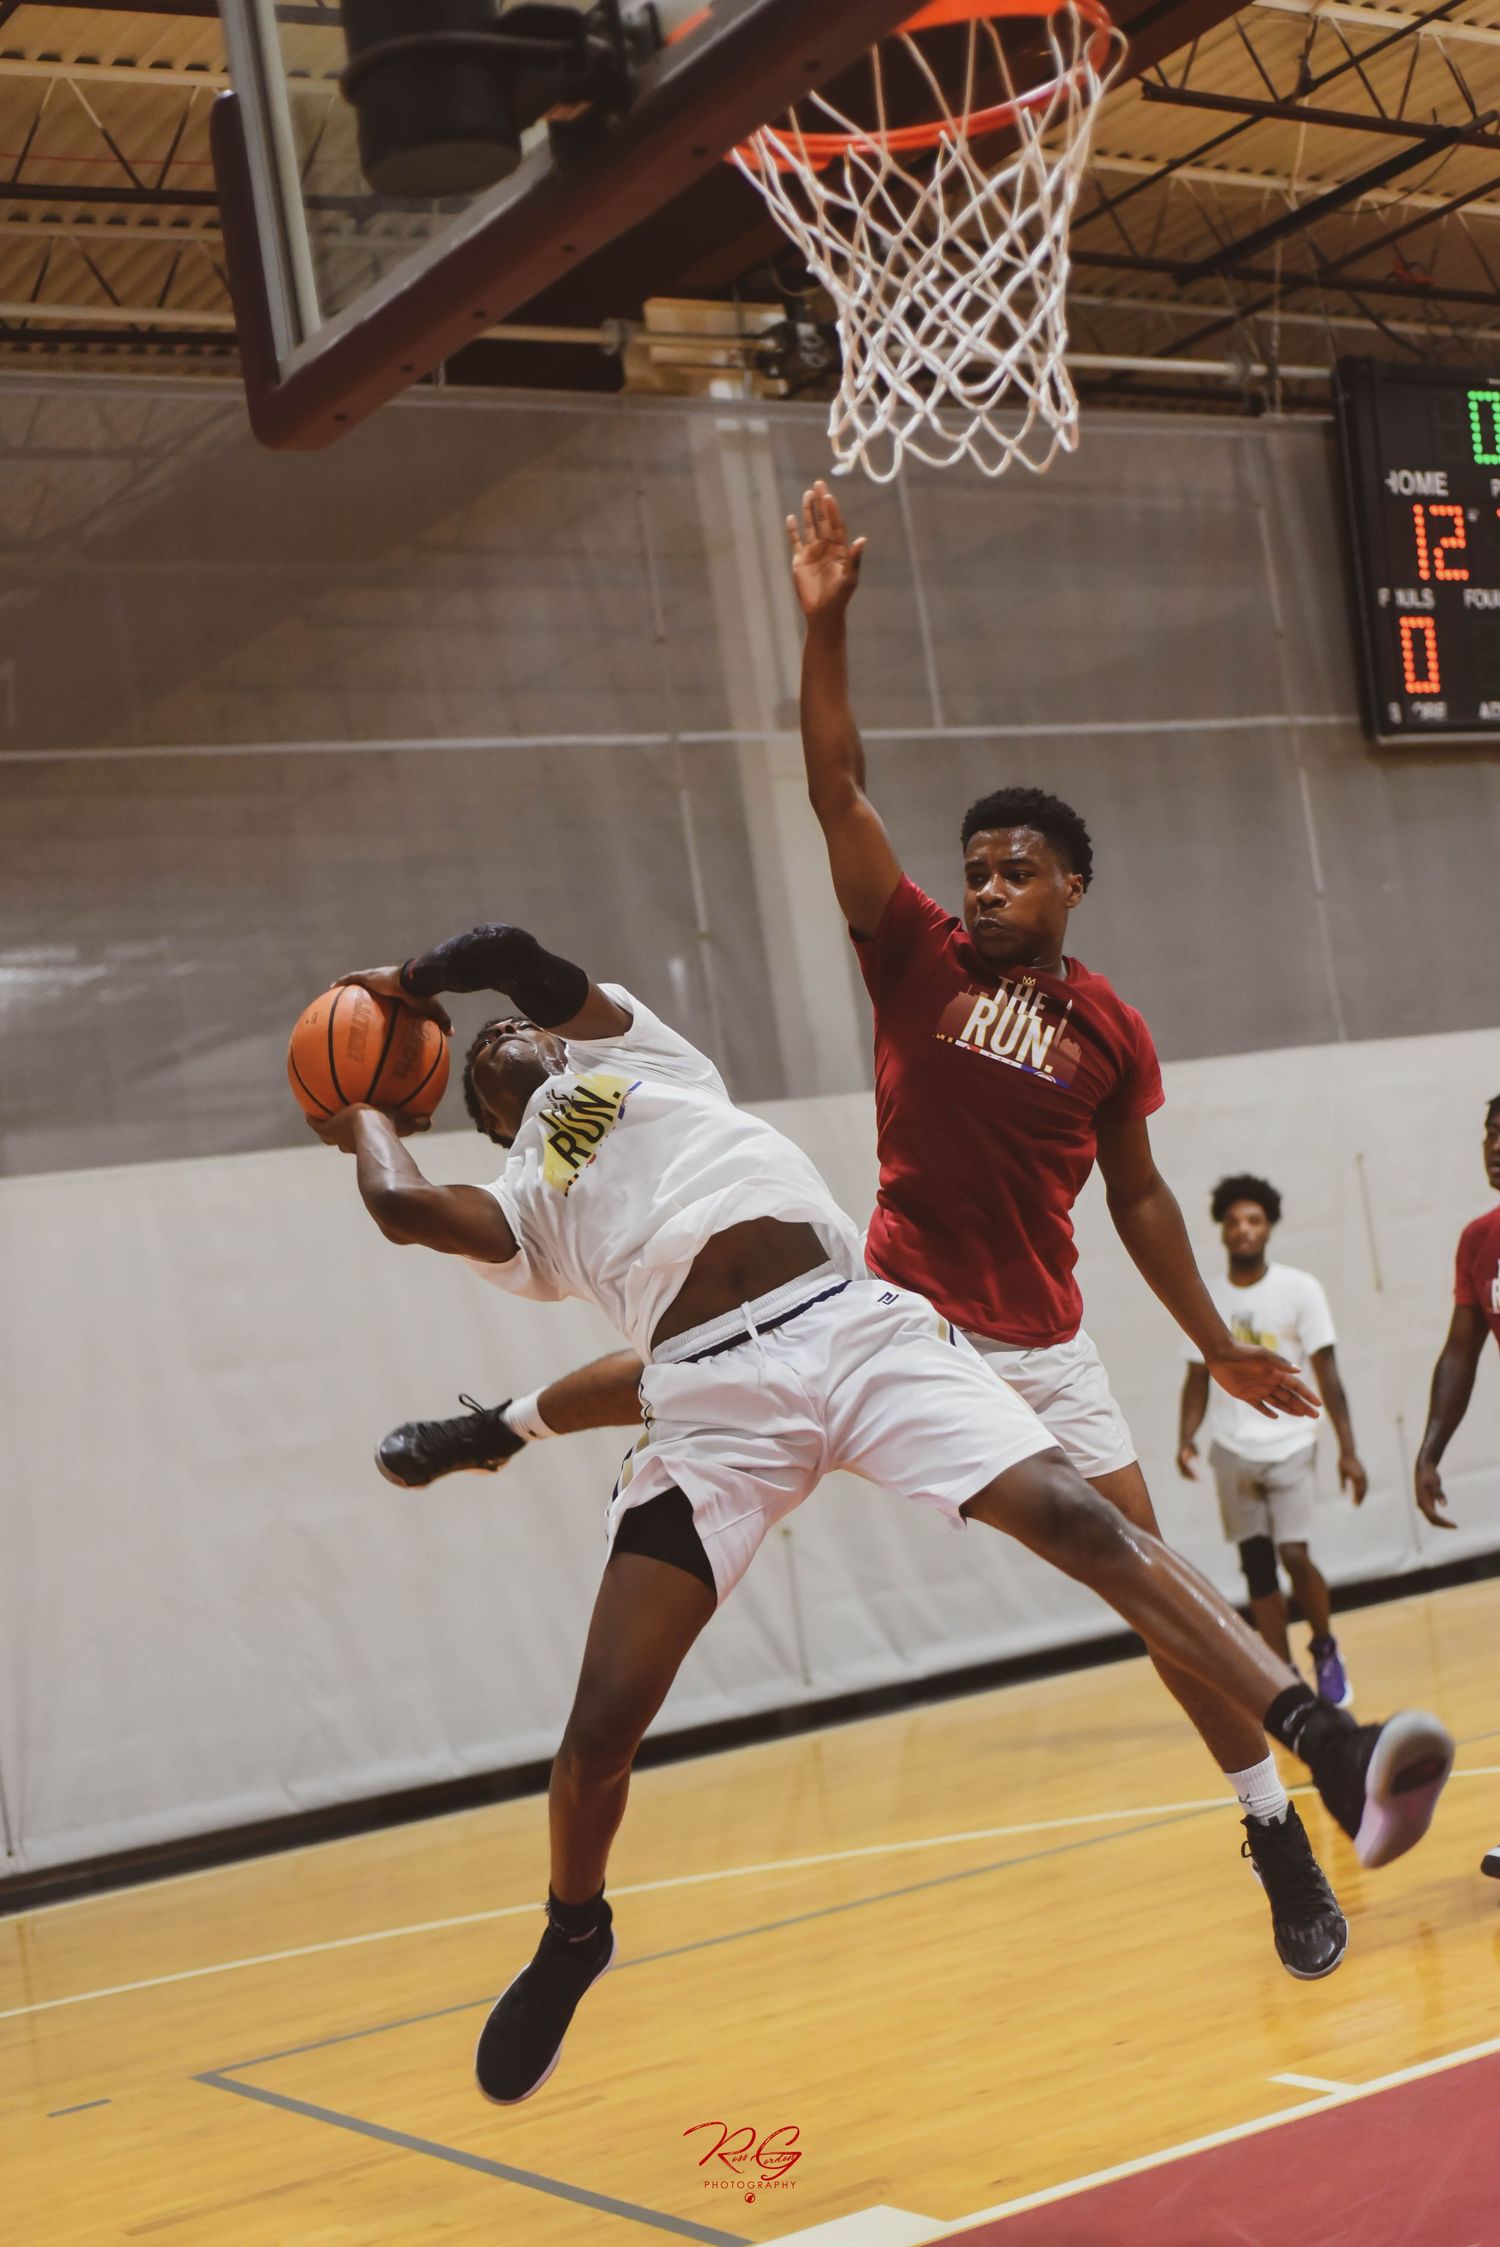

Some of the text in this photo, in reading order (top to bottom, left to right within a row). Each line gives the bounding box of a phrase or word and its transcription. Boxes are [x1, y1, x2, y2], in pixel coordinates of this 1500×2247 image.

[1467, 390, 1500, 465] 0
[1413, 503, 1470, 581] 12
[1399, 616, 1441, 694] 0
[960, 995, 1055, 1074] RUN.
